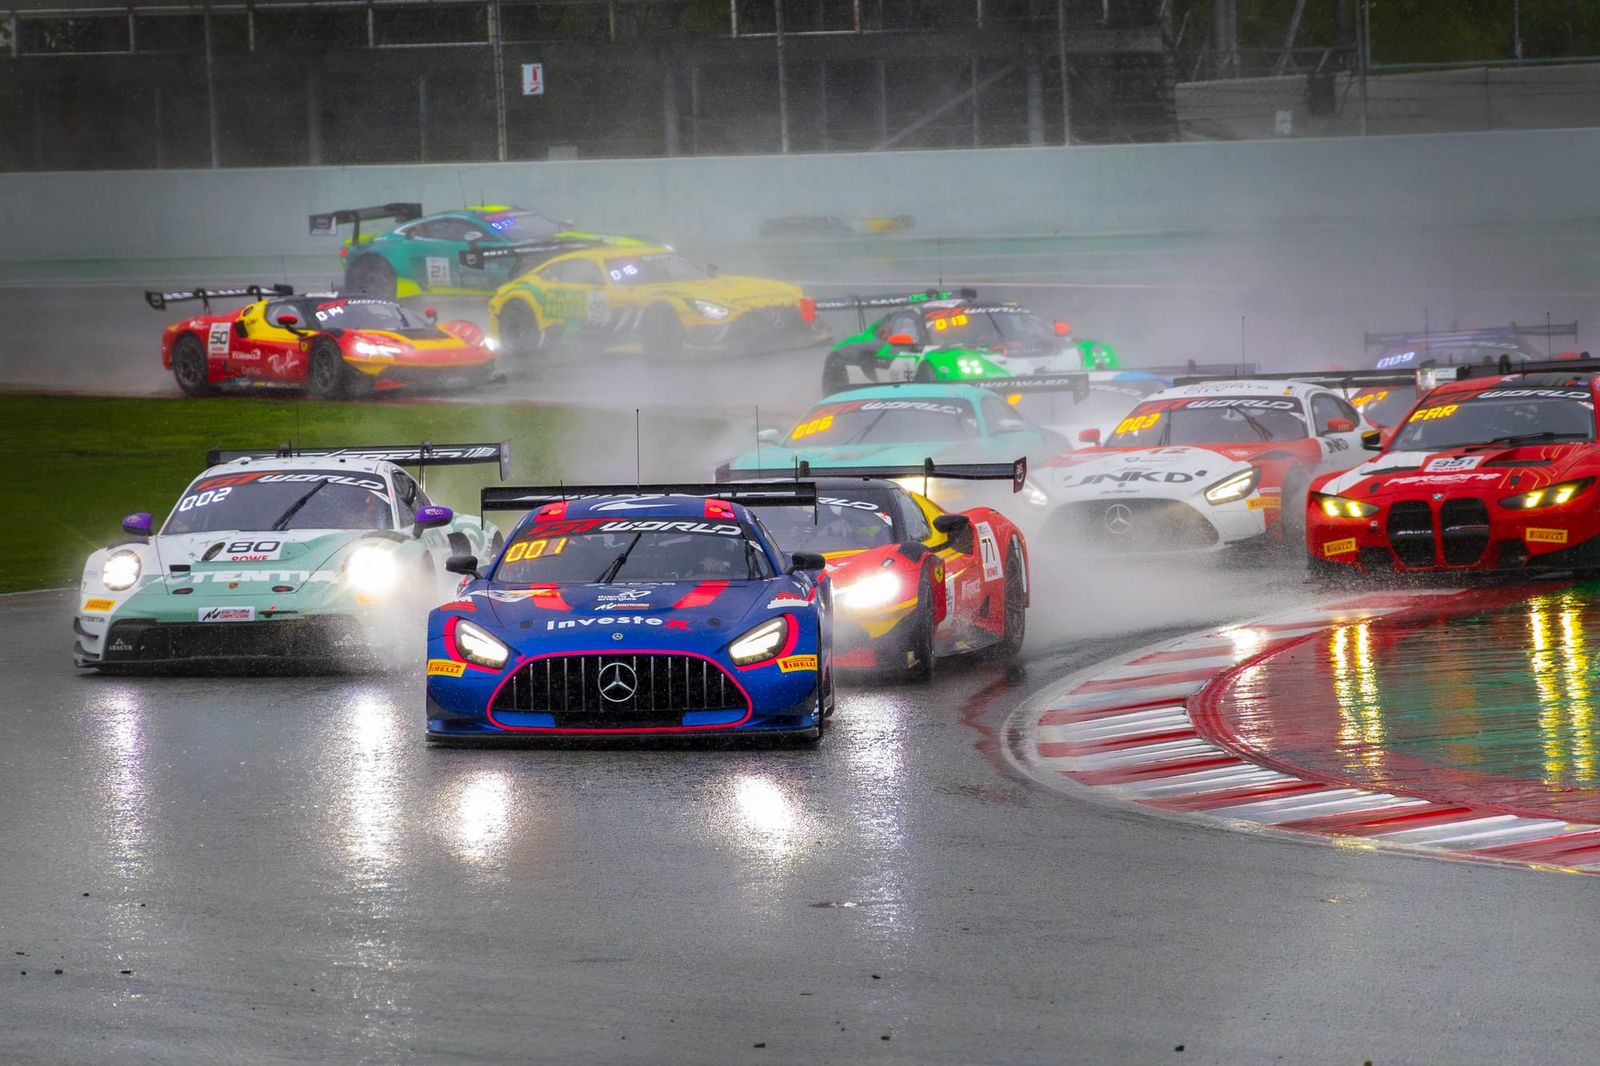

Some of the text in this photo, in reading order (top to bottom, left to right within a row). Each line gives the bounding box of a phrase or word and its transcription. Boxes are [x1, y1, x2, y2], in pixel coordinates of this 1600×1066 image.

[210, 331, 229, 344] 50
[1477, 390, 1591, 399] WORLD
[861, 400, 962, 414] WORLD
[1185, 399, 1296, 410] WORLD
[1408, 404, 1461, 422] FAR
[1114, 412, 1161, 435] 003
[257, 474, 386, 491] WORLD
[178, 487, 233, 512] 002
[600, 521, 743, 536] WORLD
[1530, 531, 1565, 541] PIRELLI
[226, 541, 282, 553] 80
[505, 537, 568, 563] 001
[981, 537, 997, 563] 71
[429, 663, 461, 674] PIRELLI
[782, 658, 816, 670] PIRELLI
